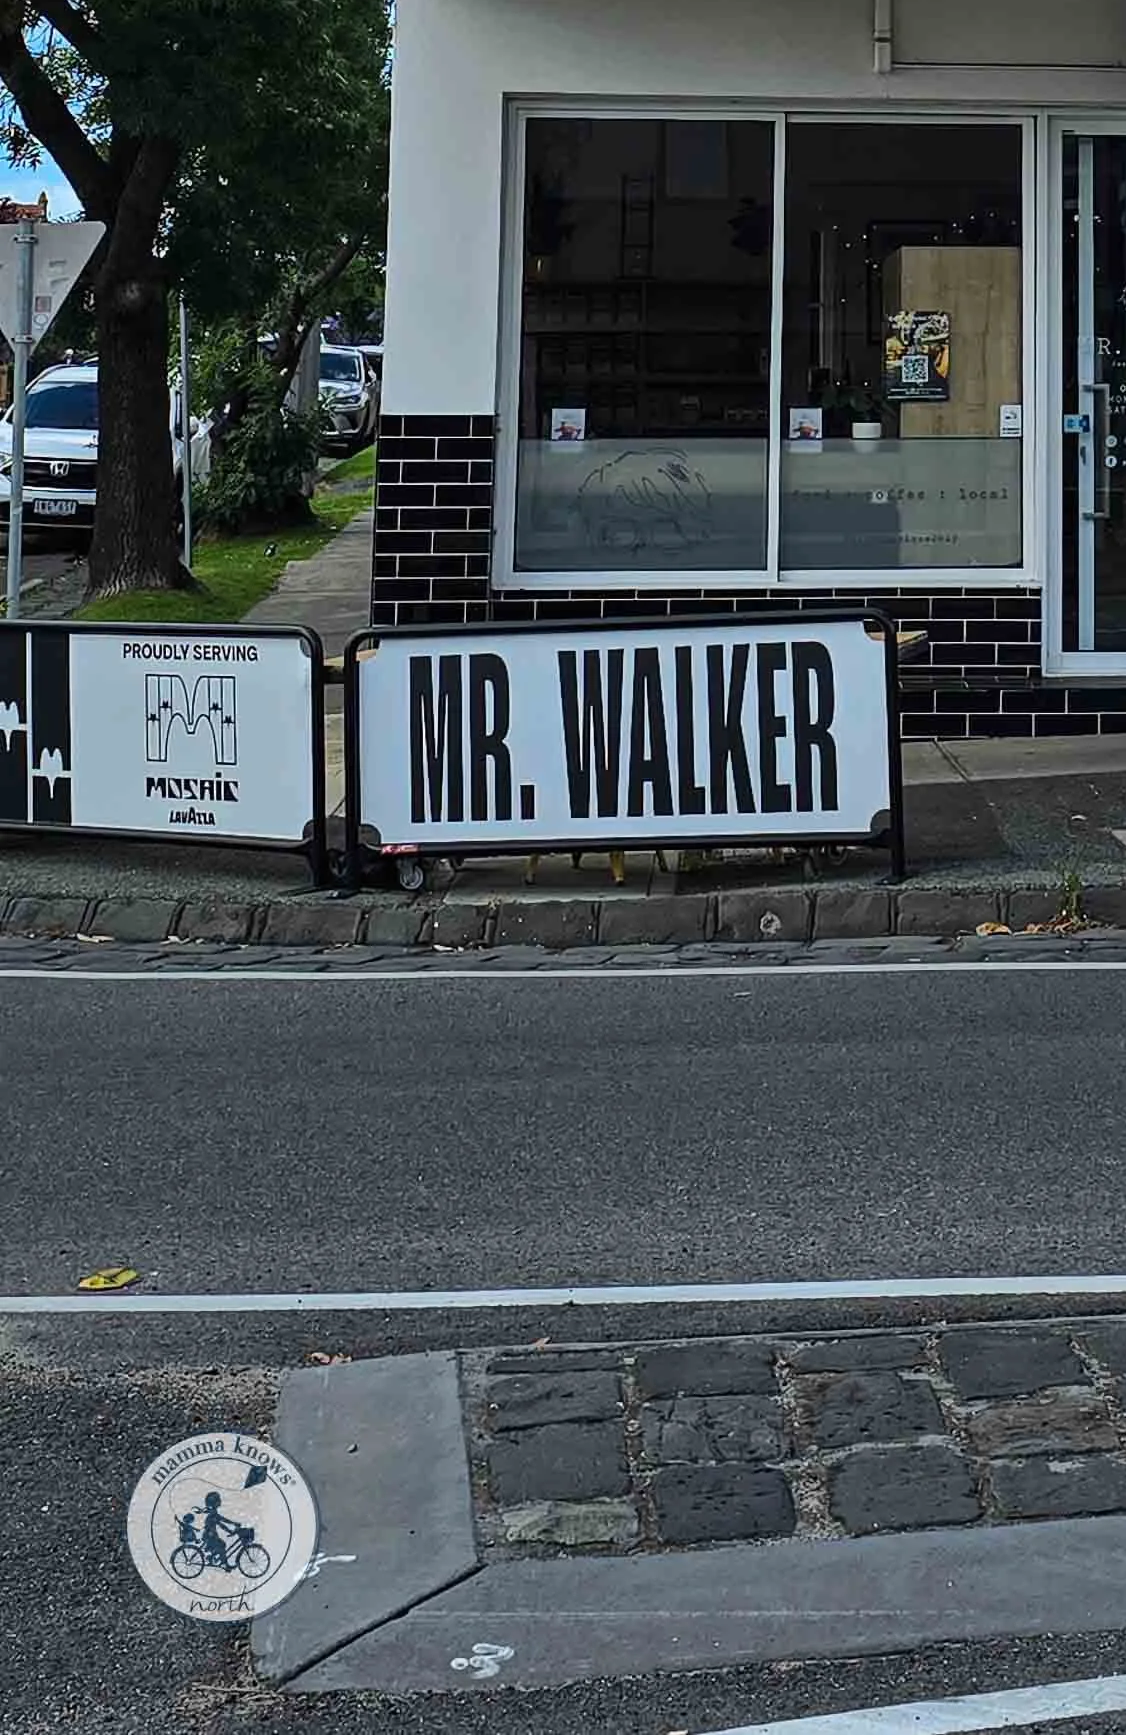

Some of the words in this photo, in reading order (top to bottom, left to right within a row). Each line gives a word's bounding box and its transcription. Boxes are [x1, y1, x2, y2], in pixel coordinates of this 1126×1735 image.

[123, 643, 189, 660] PROUDLY
[193, 644, 258, 662] SERVING
[409, 652, 535, 824] MR.
[557, 641, 839, 819] WALKER
[169, 807, 216, 826] LAVAZZA
